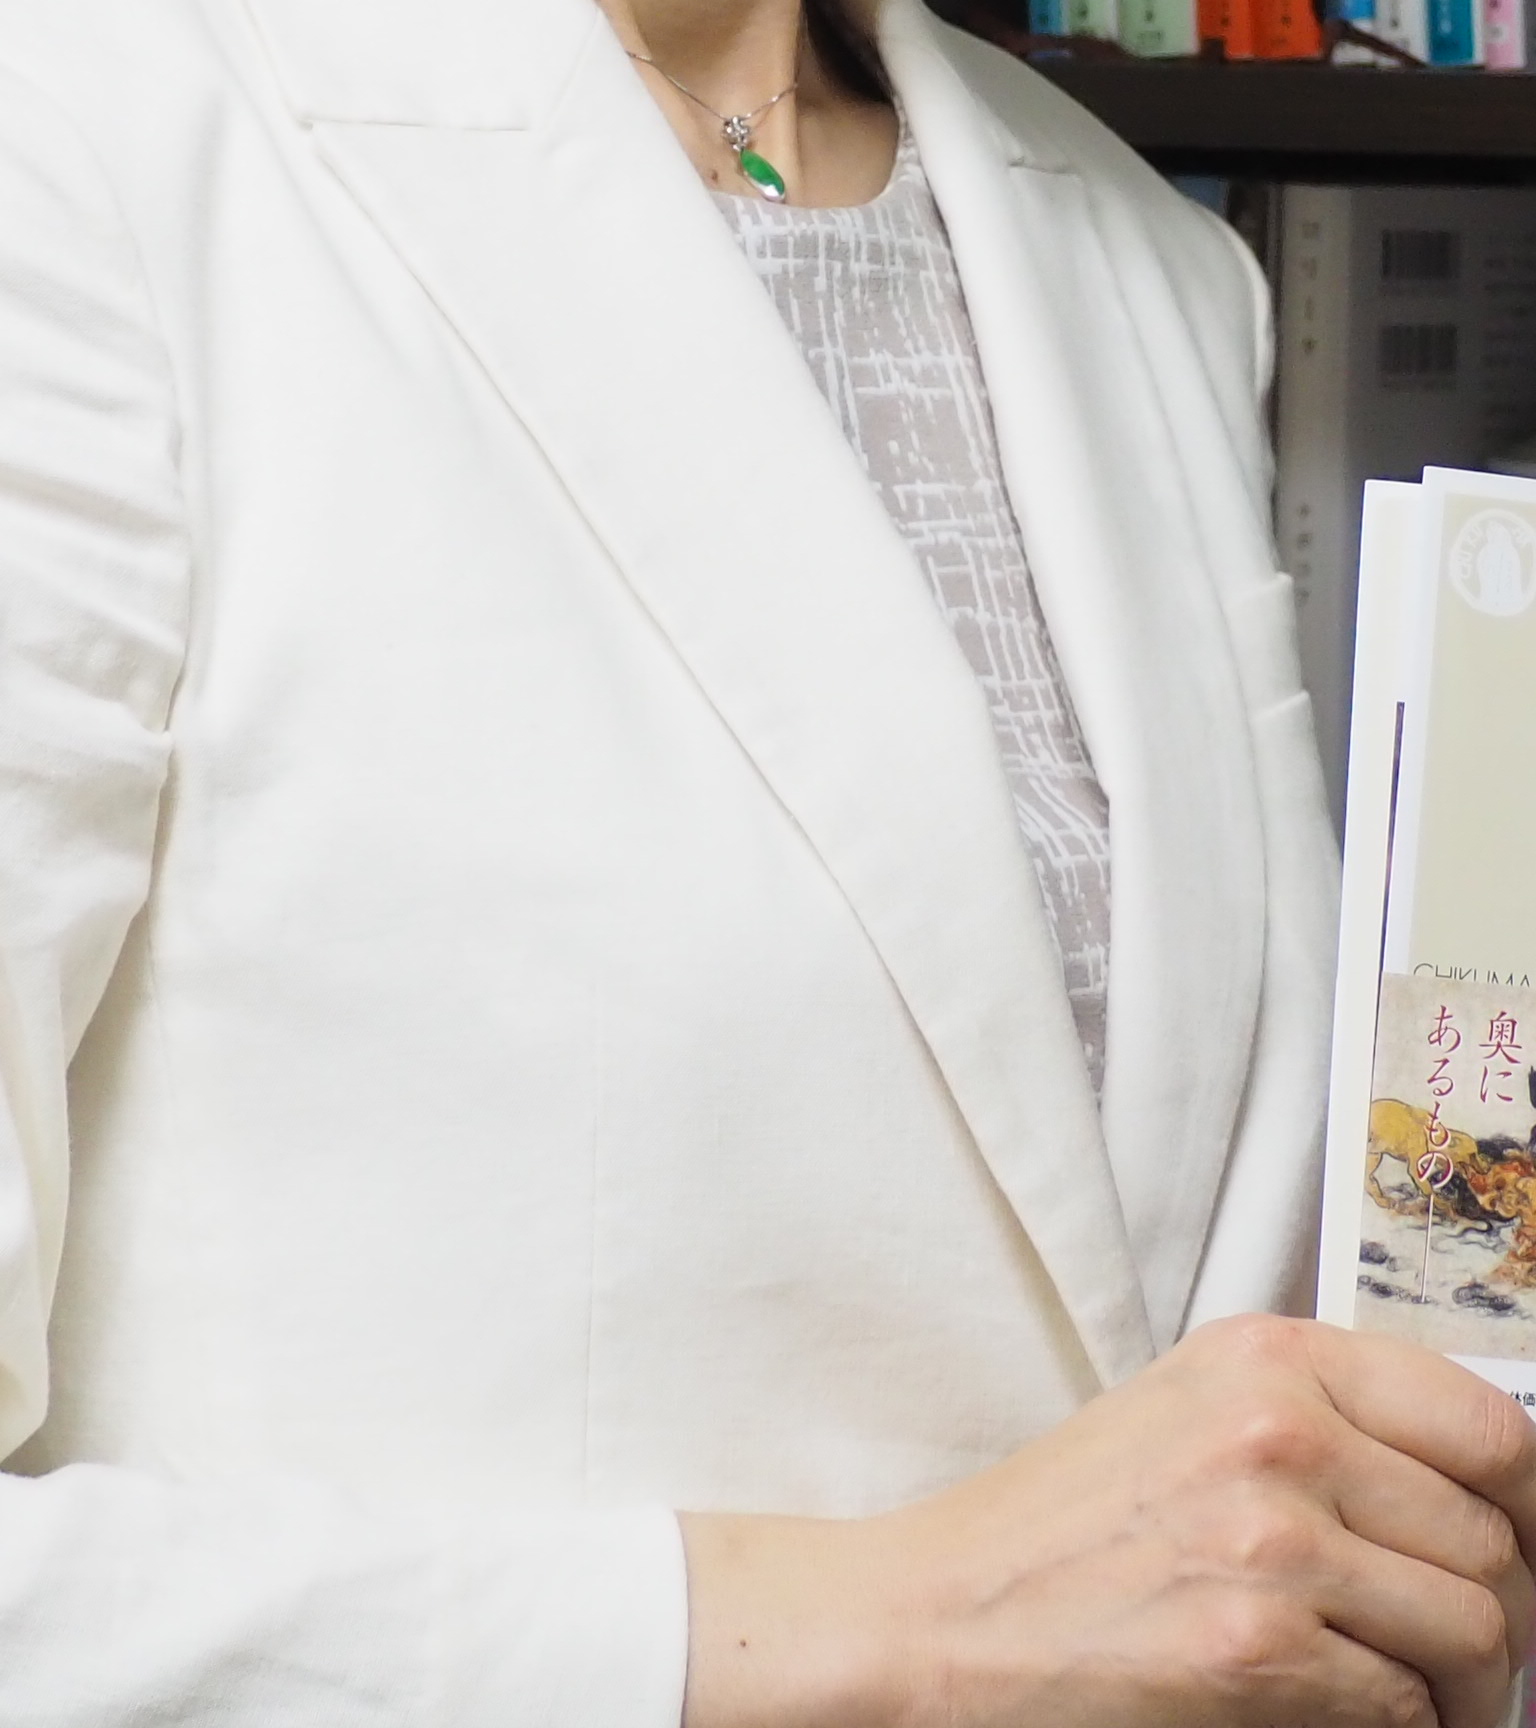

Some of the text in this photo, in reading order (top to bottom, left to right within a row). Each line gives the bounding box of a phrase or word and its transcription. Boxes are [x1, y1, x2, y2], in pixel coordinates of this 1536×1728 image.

[1415, 1003, 1463, 1190] あるもの
[1478, 1010, 1524, 1104] 奥に
